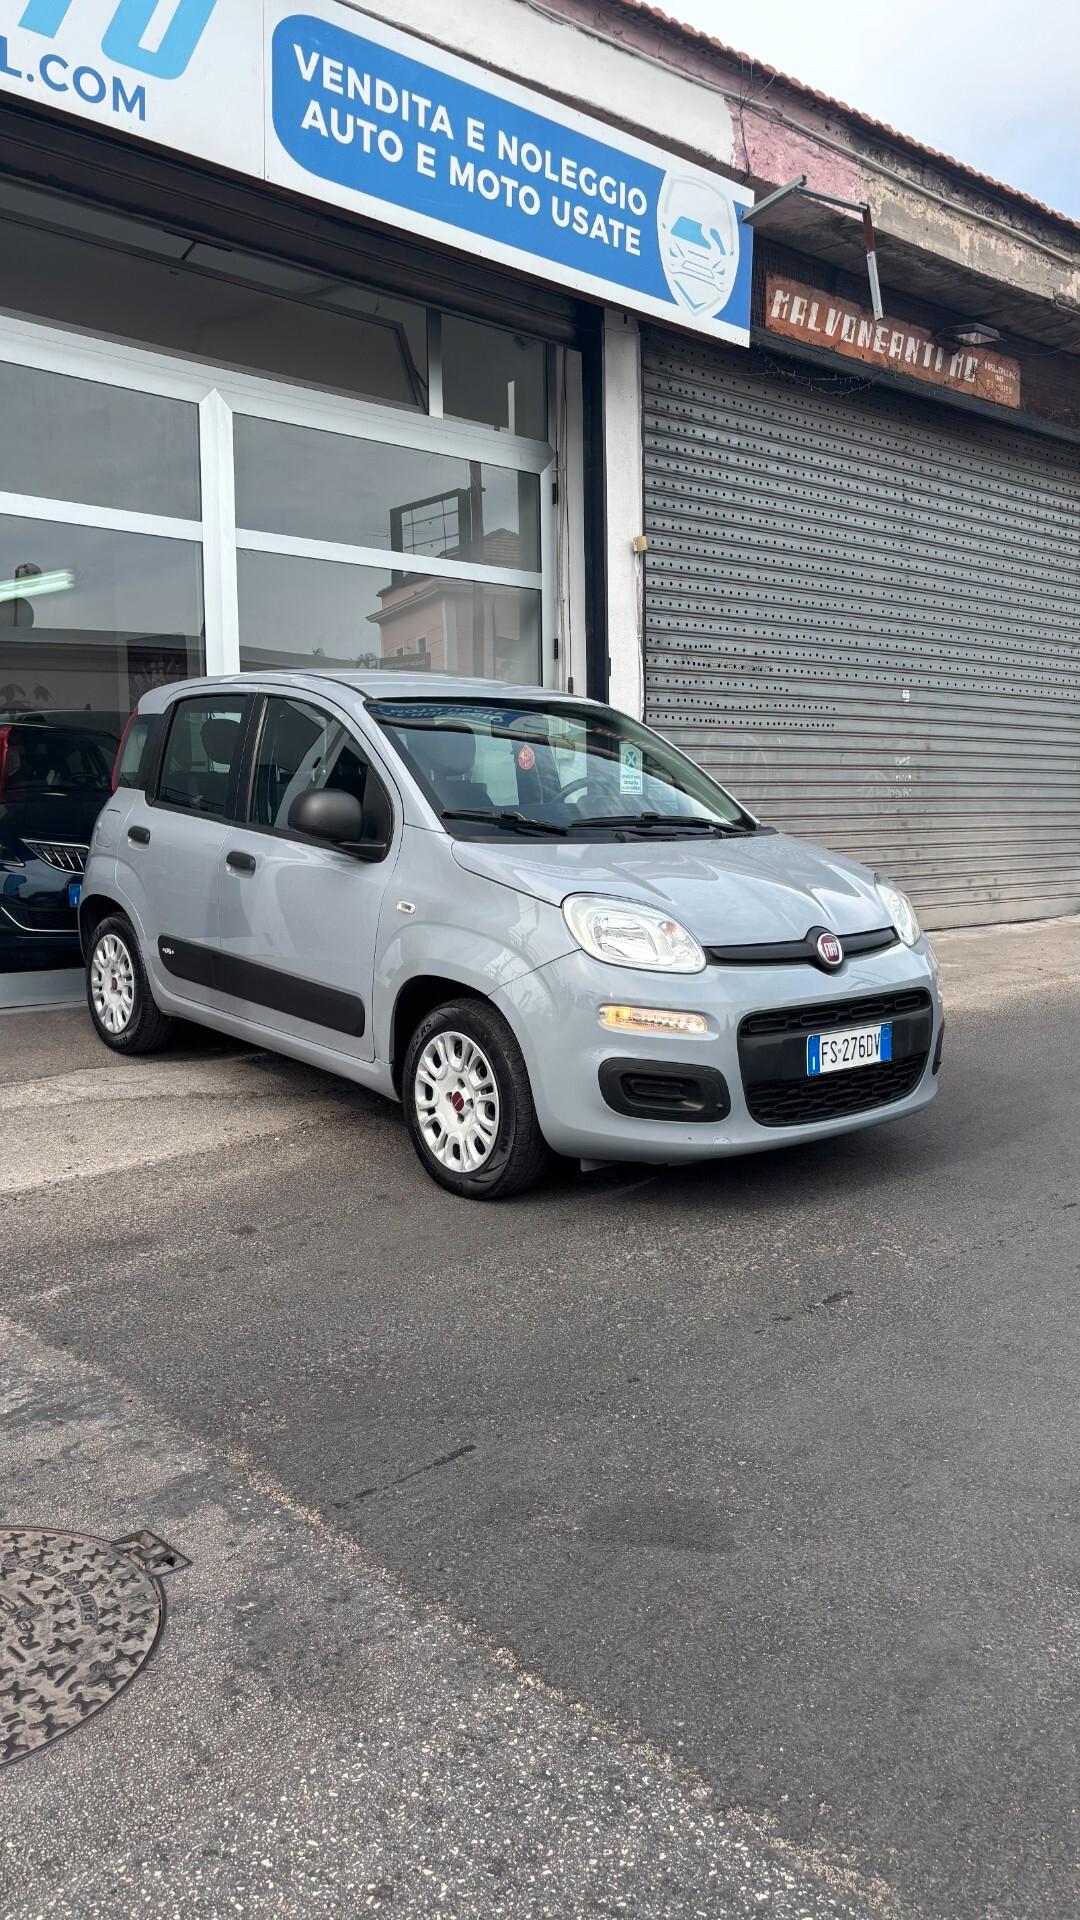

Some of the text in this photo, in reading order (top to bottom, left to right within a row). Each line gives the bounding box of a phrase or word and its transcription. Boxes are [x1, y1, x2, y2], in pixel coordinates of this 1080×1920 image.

[293, 43, 648, 216] VENDITA E NOLEGGIO
[300, 99, 641, 257] AUTO E MOTO USATE
